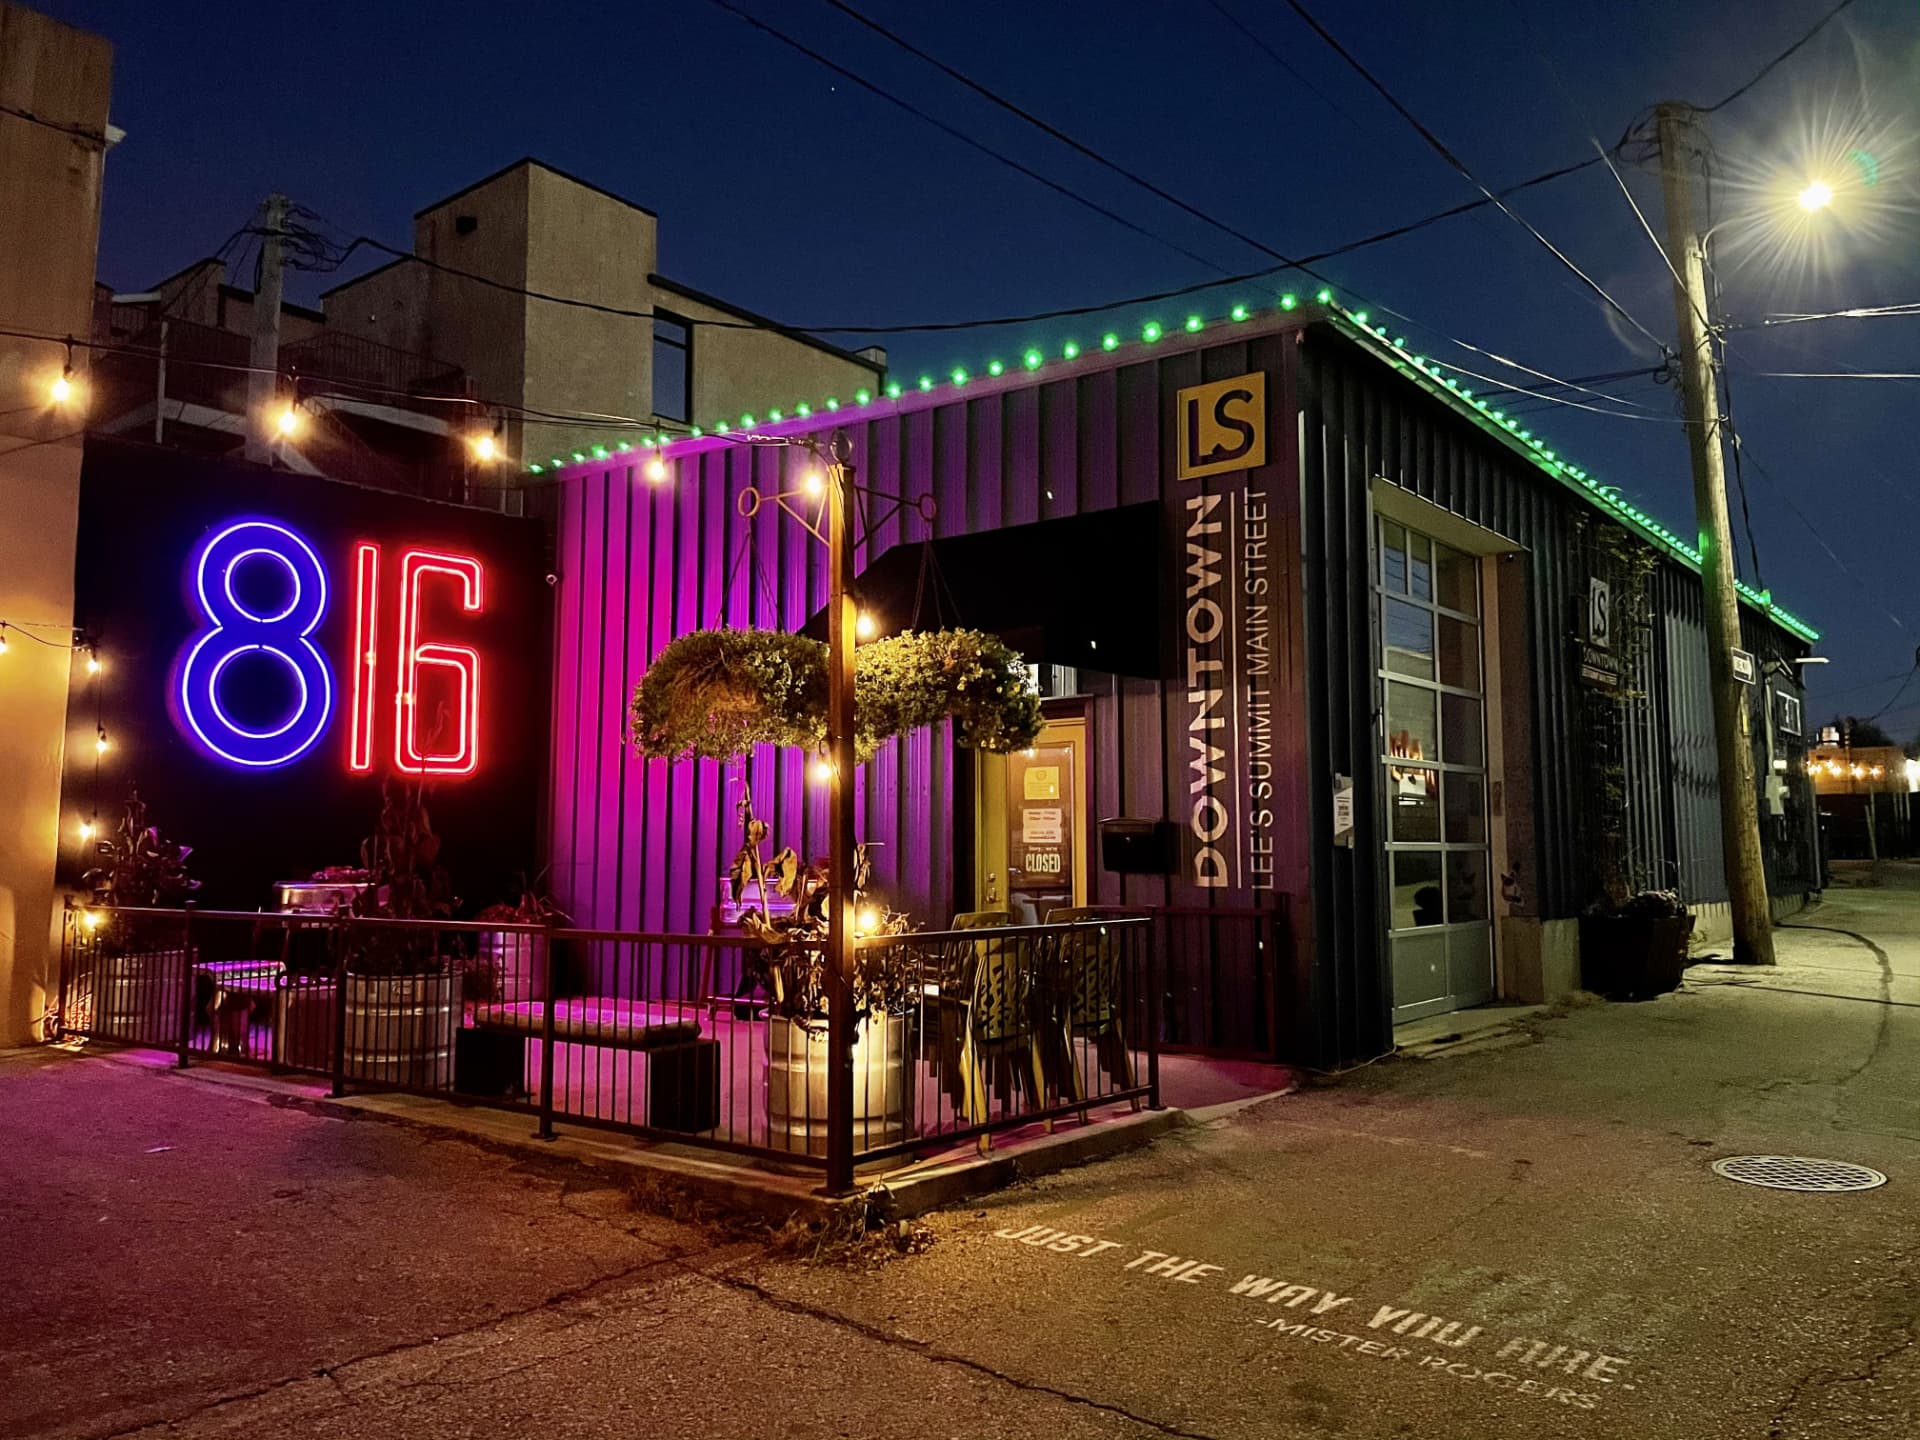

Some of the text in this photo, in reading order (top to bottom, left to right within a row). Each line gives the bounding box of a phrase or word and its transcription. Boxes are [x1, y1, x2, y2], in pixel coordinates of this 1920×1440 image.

[1187, 389, 1255, 468] LS
[180, 516, 484, 775] 816
[1186, 494, 1228, 887] DOWNTOWN
[1244, 487, 1274, 889] LEE'S SUMMIT MAIN STREET
[1025, 853, 1061, 873] CLOSED
[995, 1225, 1123, 1257] JUST
[1123, 1250, 1225, 1283] THE
[1229, 1274, 1353, 1315] WAY
[1367, 1305, 1484, 1347] YOU
